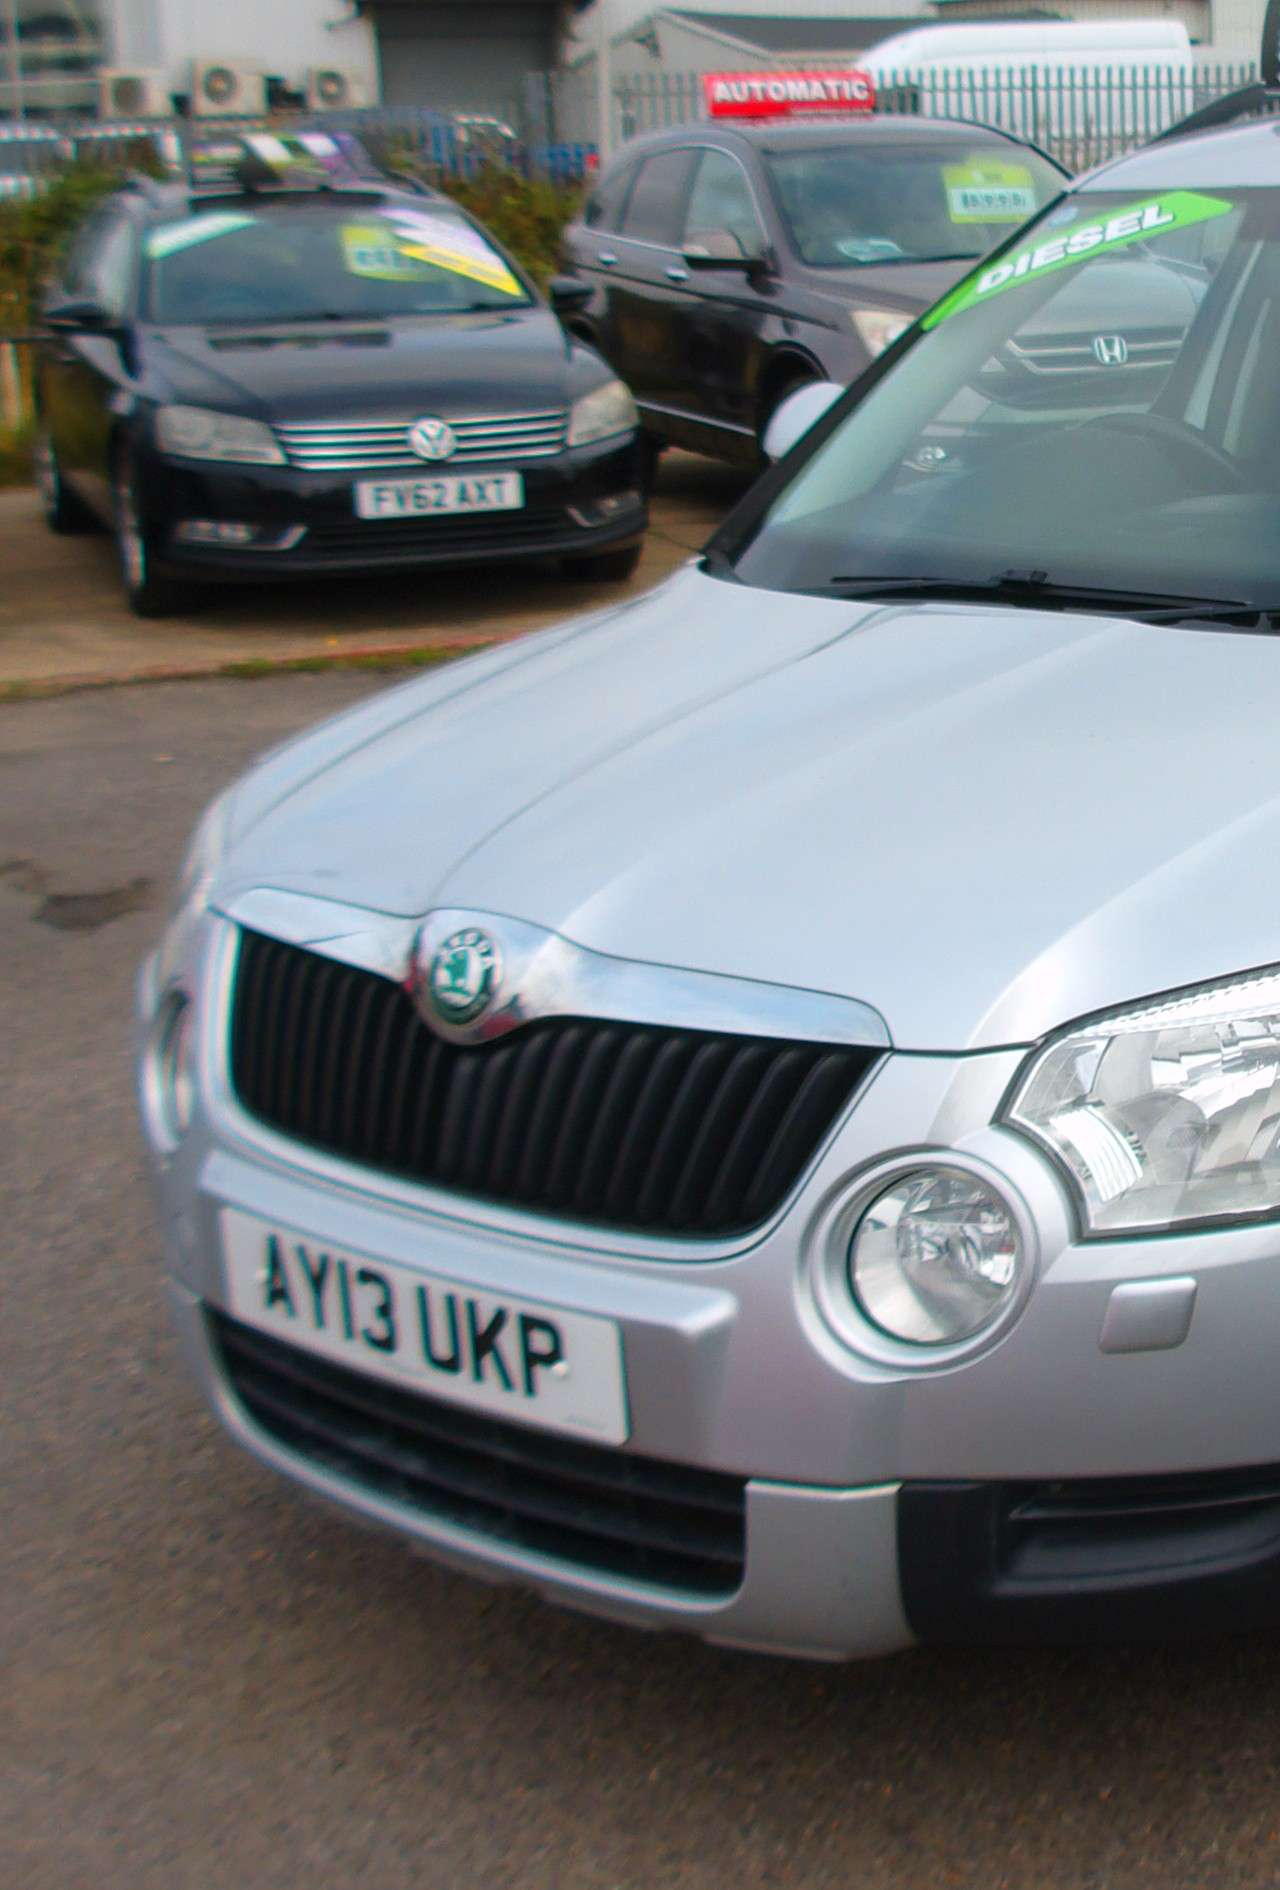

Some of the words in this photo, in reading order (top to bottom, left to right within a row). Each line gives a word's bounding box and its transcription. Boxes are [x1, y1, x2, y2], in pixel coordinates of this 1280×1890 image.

[713, 80, 869, 103] AUTOMATIC
[975, 203, 1175, 294] DIESEL
[372, 483, 449, 513] FV62
[456, 478, 508, 506] AXT
[263, 1232, 398, 1354] AY13
[416, 1283, 565, 1398] UKP
